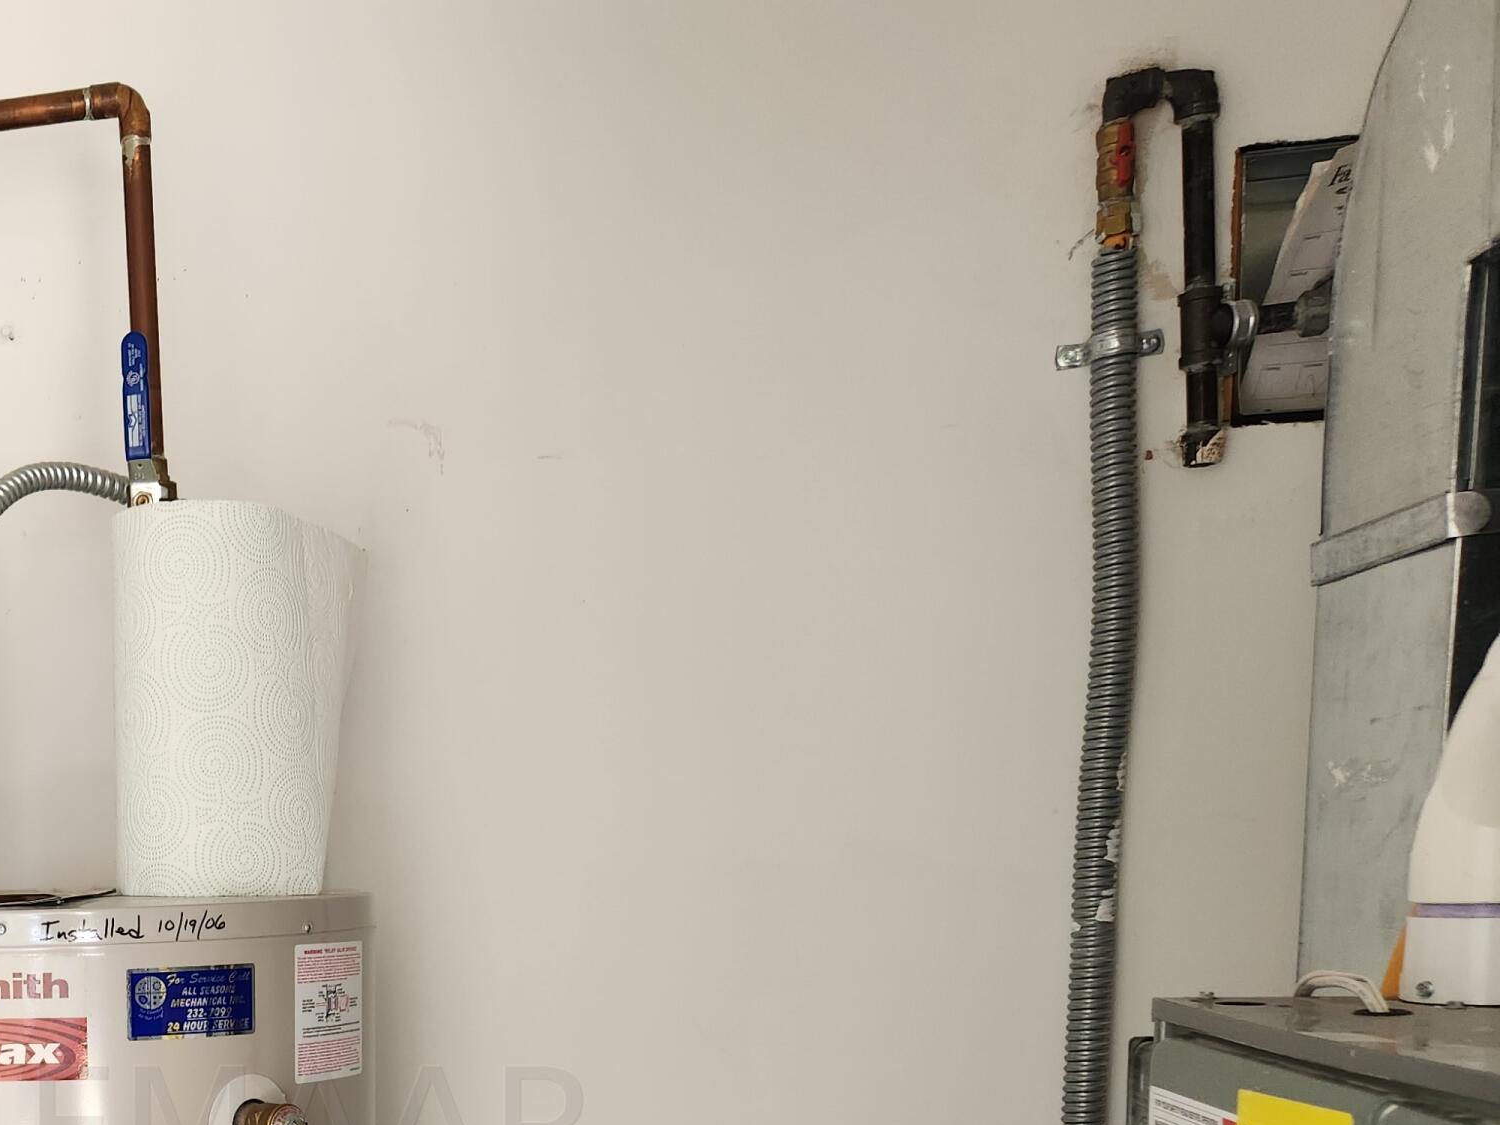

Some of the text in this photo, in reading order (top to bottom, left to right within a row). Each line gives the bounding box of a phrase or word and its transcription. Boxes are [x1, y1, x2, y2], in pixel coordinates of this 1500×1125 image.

[40, 910, 227, 942] Installed 10/19/06
[166, 973, 185, 987] For
[189, 972, 225, 984] Service
[182, 985, 236, 996] ALL SEASONS
[170, 997, 227, 1008] MECHANICAL
[167, 1022, 180, 1033] 24
[183, 1019, 209, 1031] HOUR
